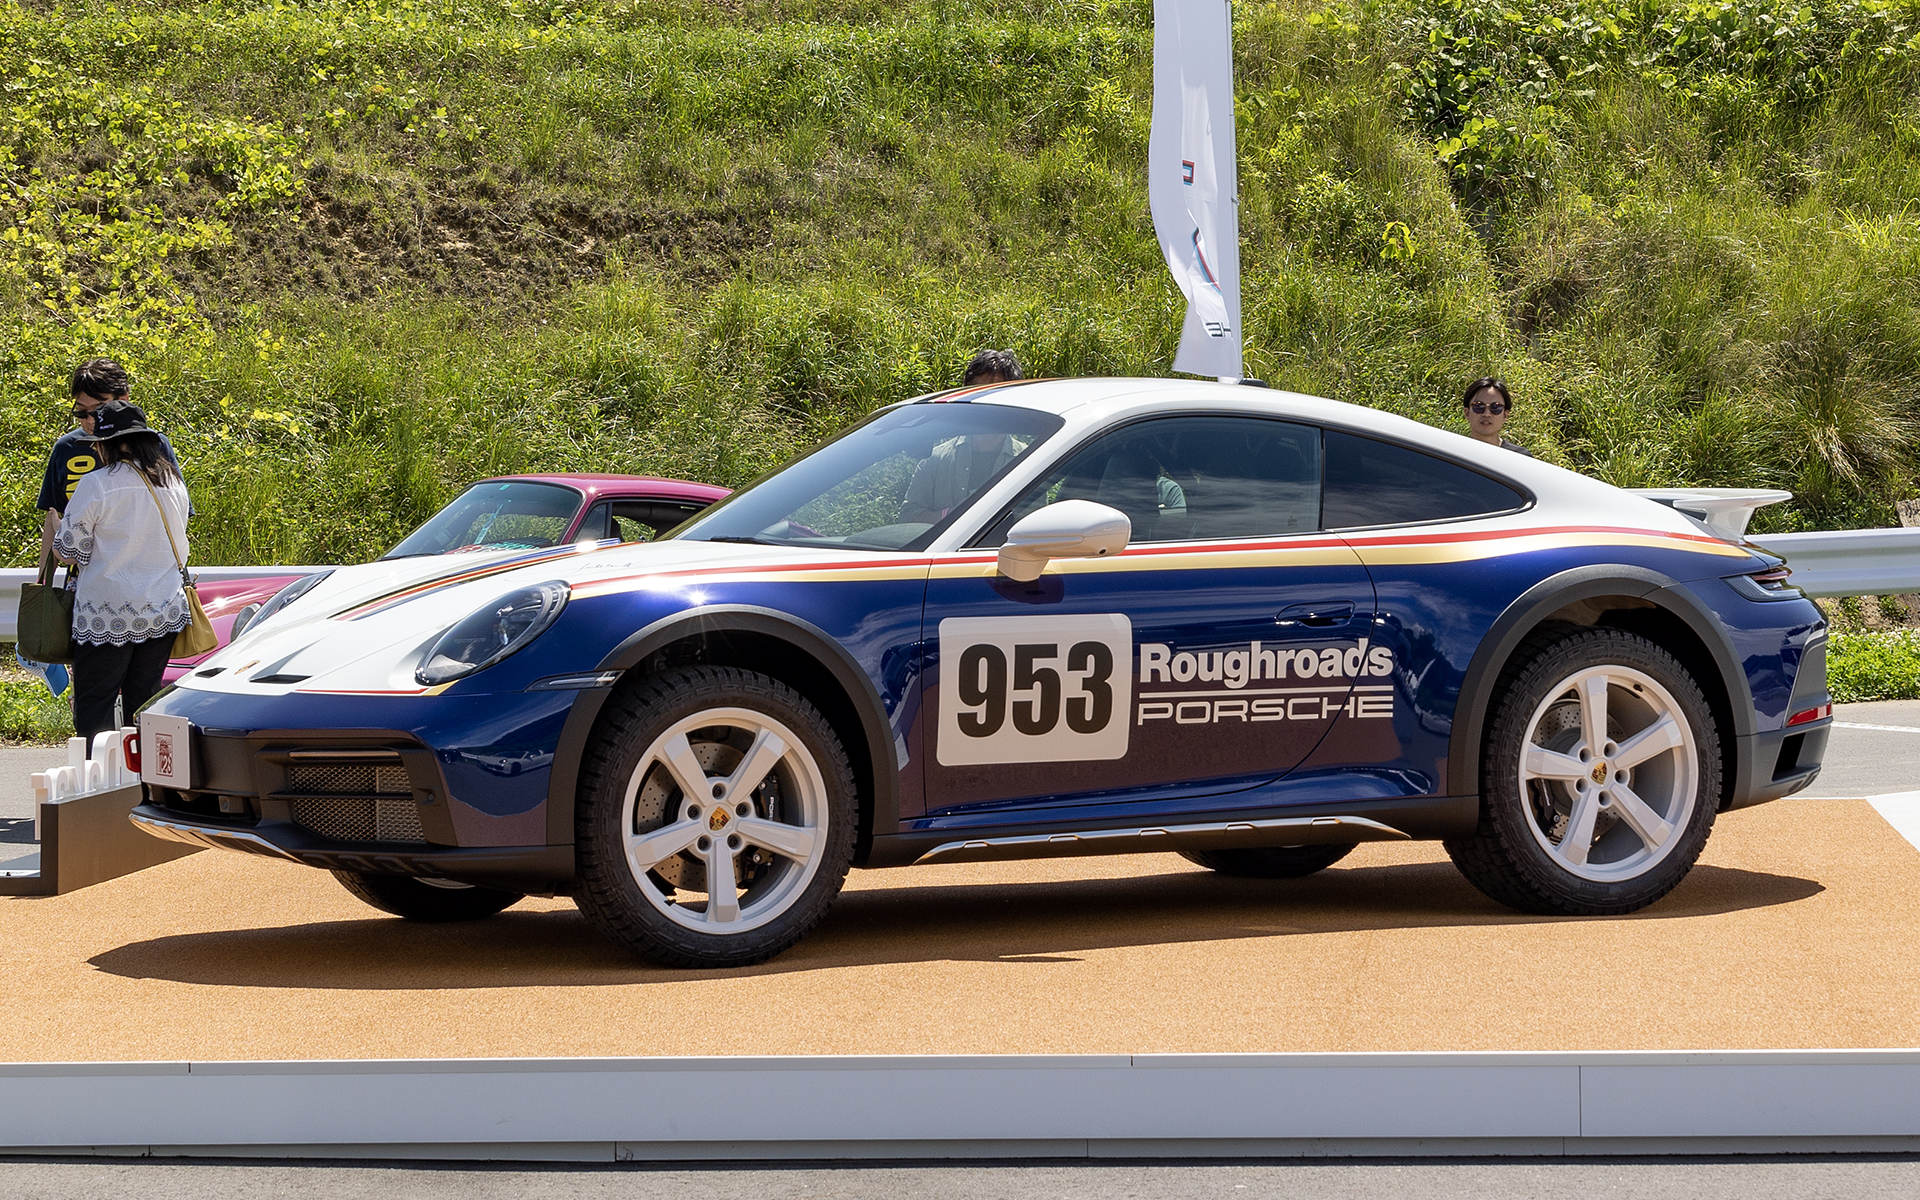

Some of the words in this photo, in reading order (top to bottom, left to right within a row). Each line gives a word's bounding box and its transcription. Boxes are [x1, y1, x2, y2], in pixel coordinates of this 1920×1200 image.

[957, 641, 1114, 737] 953
[1139, 639, 1393, 689] Roughroads
[1138, 697, 1393, 725] PORSCHE
